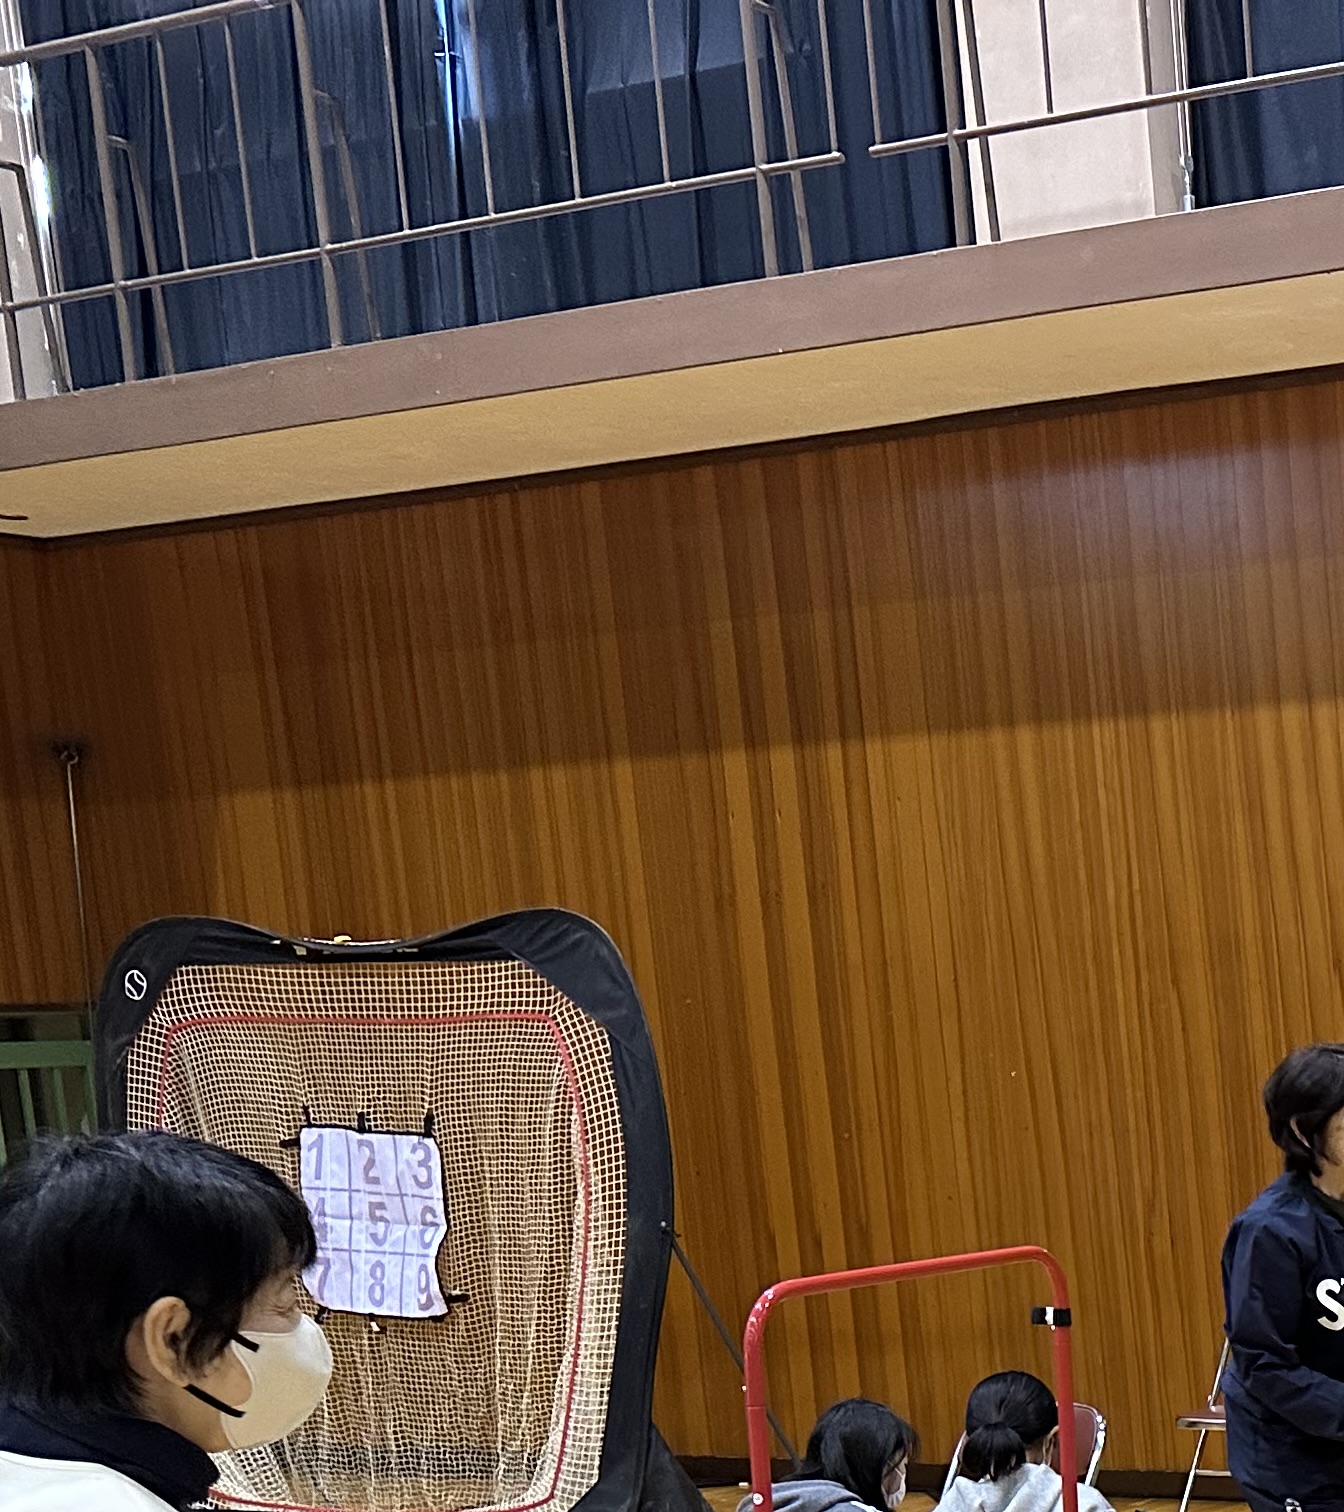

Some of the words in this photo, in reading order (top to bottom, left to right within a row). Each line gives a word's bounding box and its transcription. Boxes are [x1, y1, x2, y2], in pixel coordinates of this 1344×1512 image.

[307, 1133, 324, 1181] 1
[357, 1138, 381, 1186] 2
[410, 1141, 434, 1190] 3
[368, 1201, 391, 1247] 5
[420, 1205, 440, 1250] 6
[315, 1256, 332, 1302] 7
[368, 1259, 386, 1308] 8
[416, 1263, 435, 1311] 9
